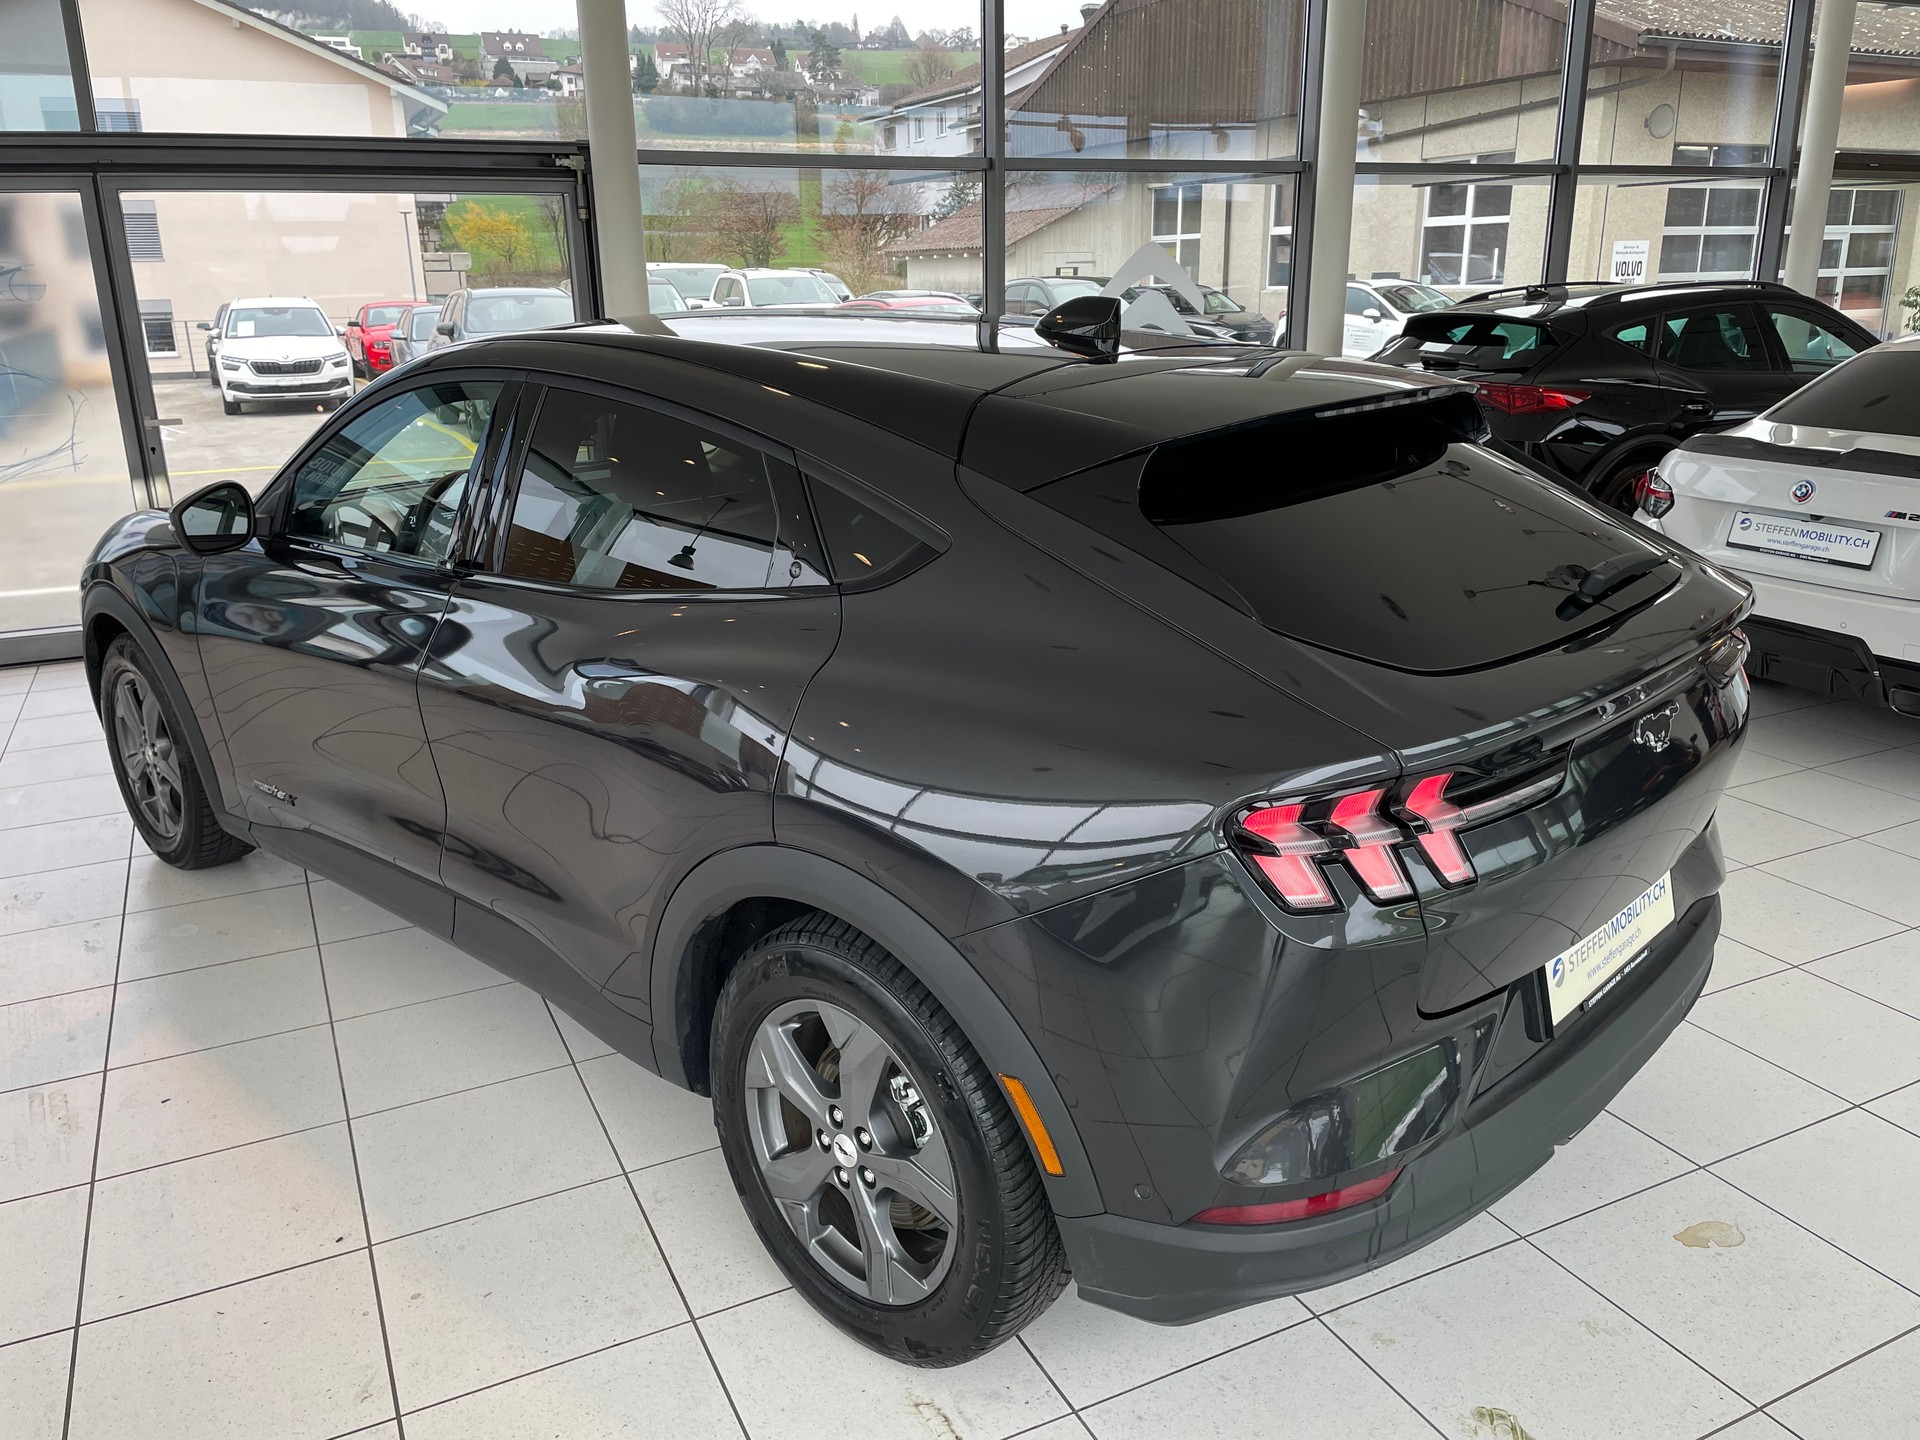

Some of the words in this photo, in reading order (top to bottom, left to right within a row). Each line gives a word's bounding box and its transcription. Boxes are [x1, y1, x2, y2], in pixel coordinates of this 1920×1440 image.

[1615, 260, 1643, 277] VOLVO
[1754, 522, 1871, 549] STEFFENMOBILITY.CH
[1766, 537, 1830, 553] www.steffengarage.ch
[1568, 879, 1666, 973] STEFFENMOBILITY.CH
[1587, 926, 1642, 980] www.steffengarage.ch
